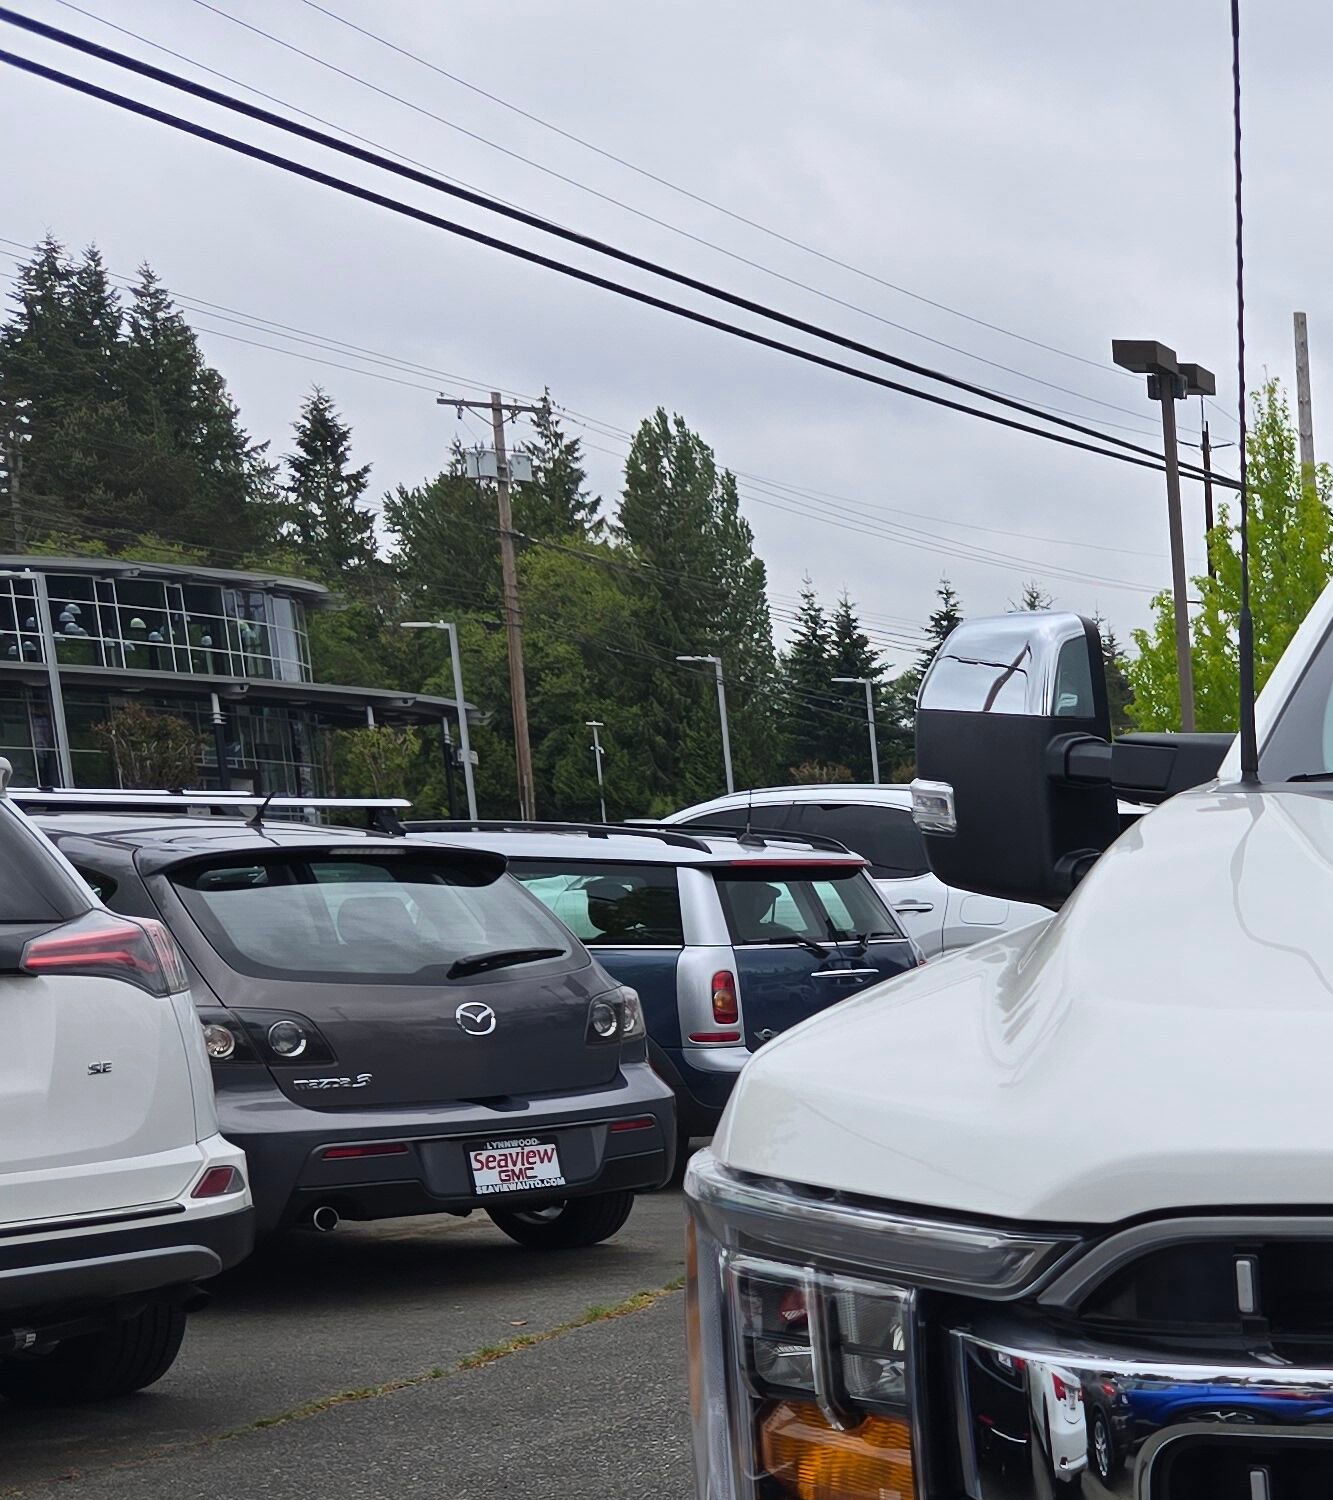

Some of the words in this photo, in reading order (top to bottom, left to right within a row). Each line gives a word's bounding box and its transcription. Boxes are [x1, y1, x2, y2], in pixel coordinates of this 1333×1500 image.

[486, 1138, 538, 1149] LYNNWOOD
[473, 1146, 557, 1171] Seaview
[498, 1166, 538, 1182] GMC
[476, 1177, 565, 1194] SEAVIEWAUTO.COM
